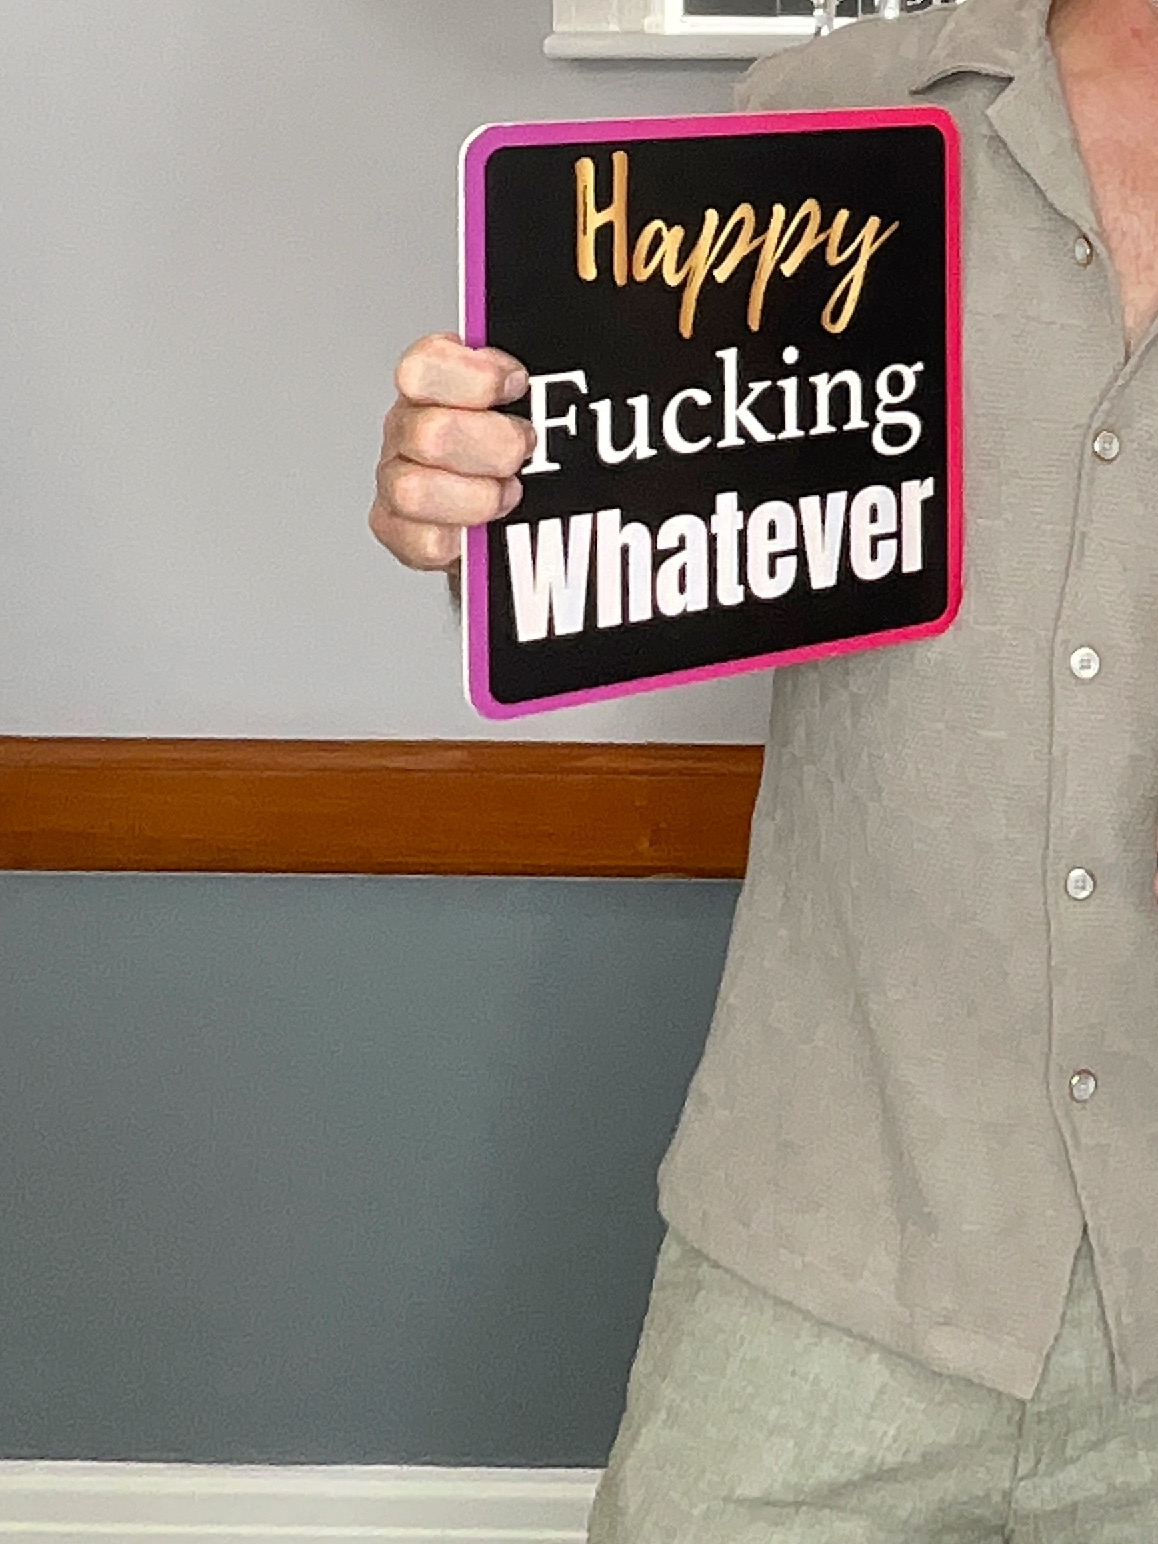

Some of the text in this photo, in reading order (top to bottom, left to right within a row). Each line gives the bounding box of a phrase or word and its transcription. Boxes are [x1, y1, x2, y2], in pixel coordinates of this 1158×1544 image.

[574, 150, 899, 339] Happy
[520, 345, 925, 475] Fucking
[505, 476, 935, 644] Whatever
